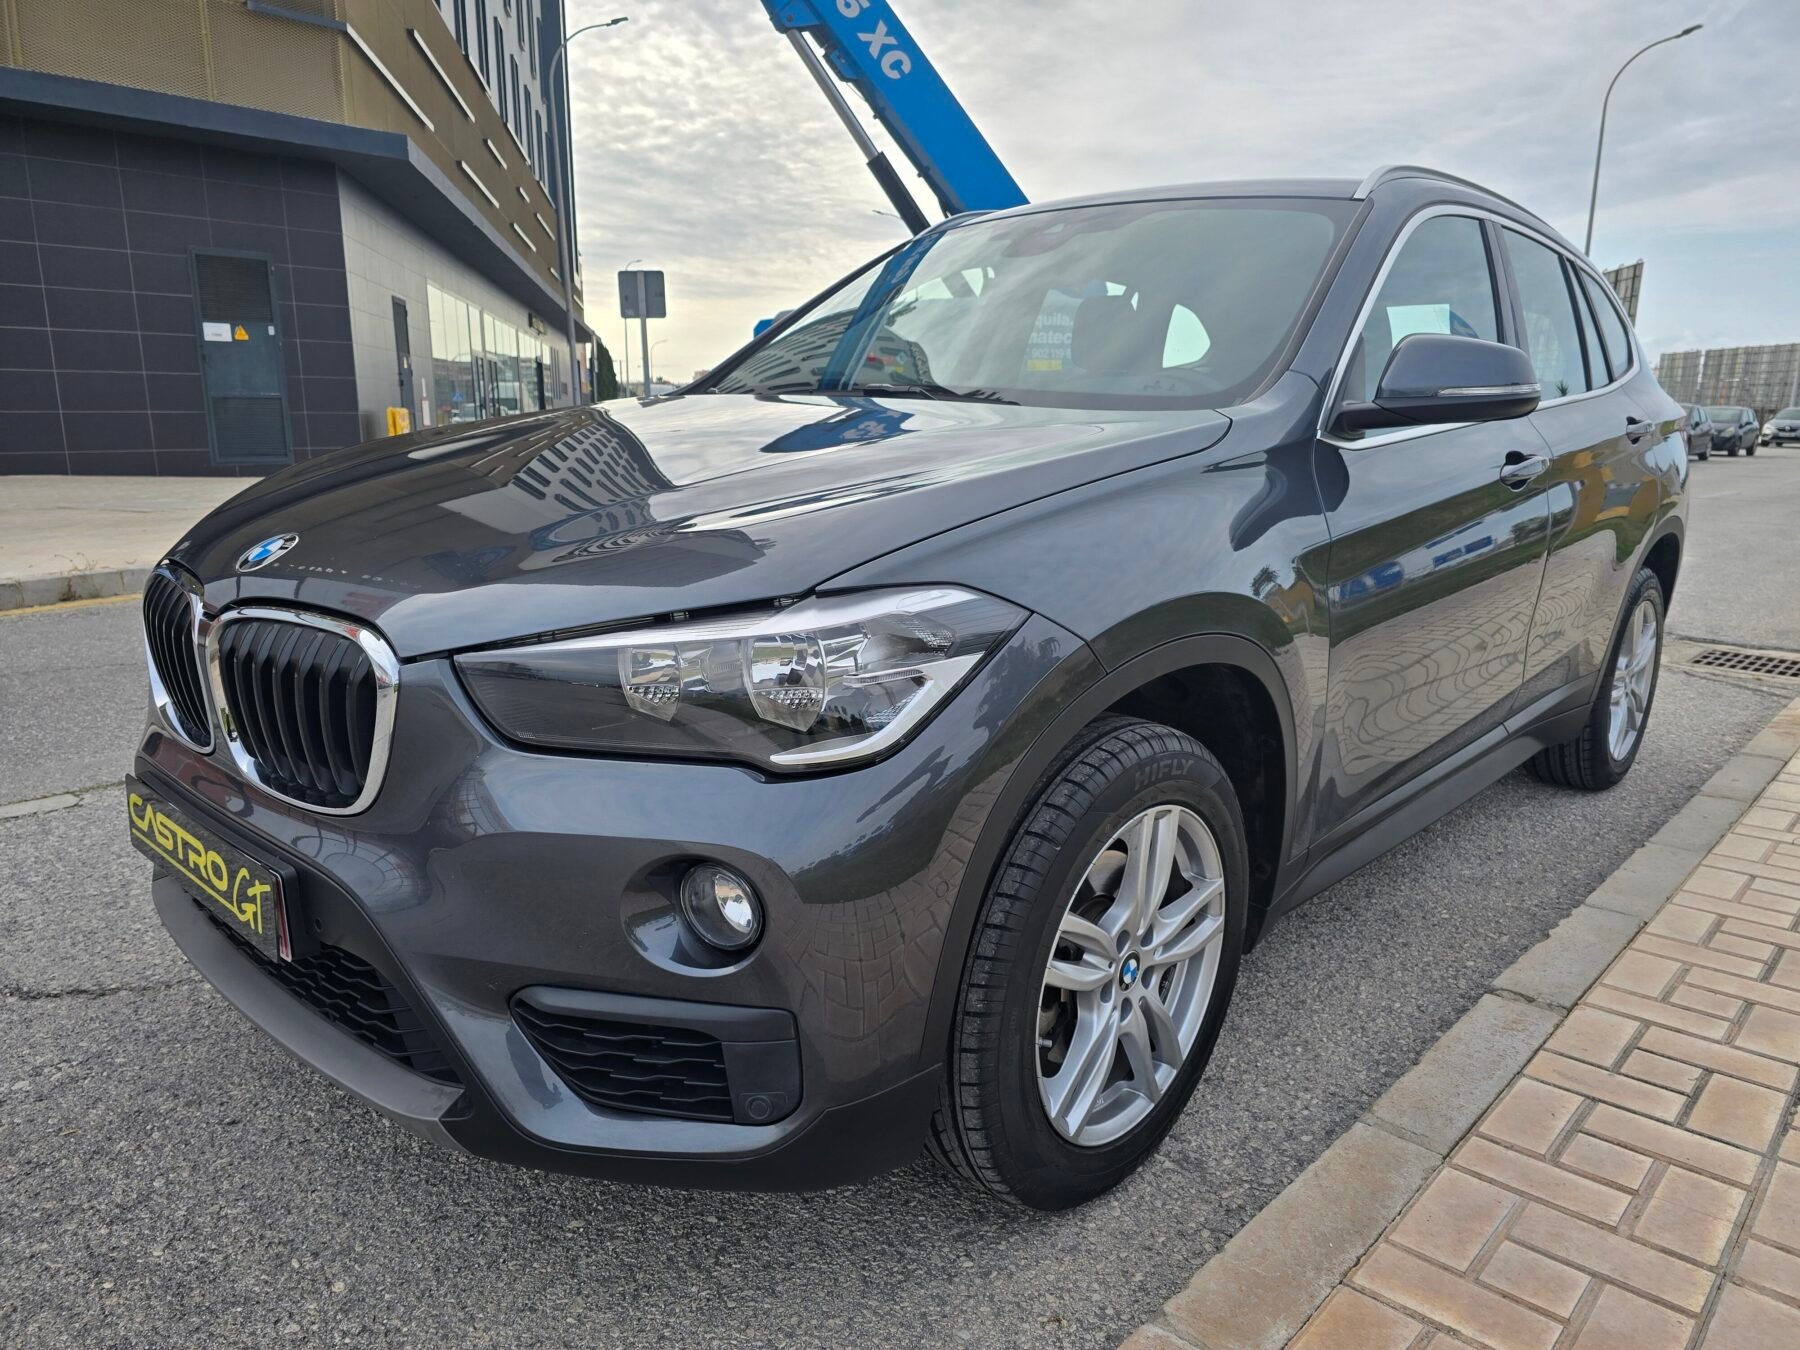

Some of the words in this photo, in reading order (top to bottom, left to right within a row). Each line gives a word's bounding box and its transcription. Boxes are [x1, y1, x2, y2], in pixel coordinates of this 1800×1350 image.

[856, 19, 912, 80] XC
[1134, 758, 1194, 791] HIFLY
[129, 793, 229, 892] CASTRO
[233, 867, 271, 934] GT
